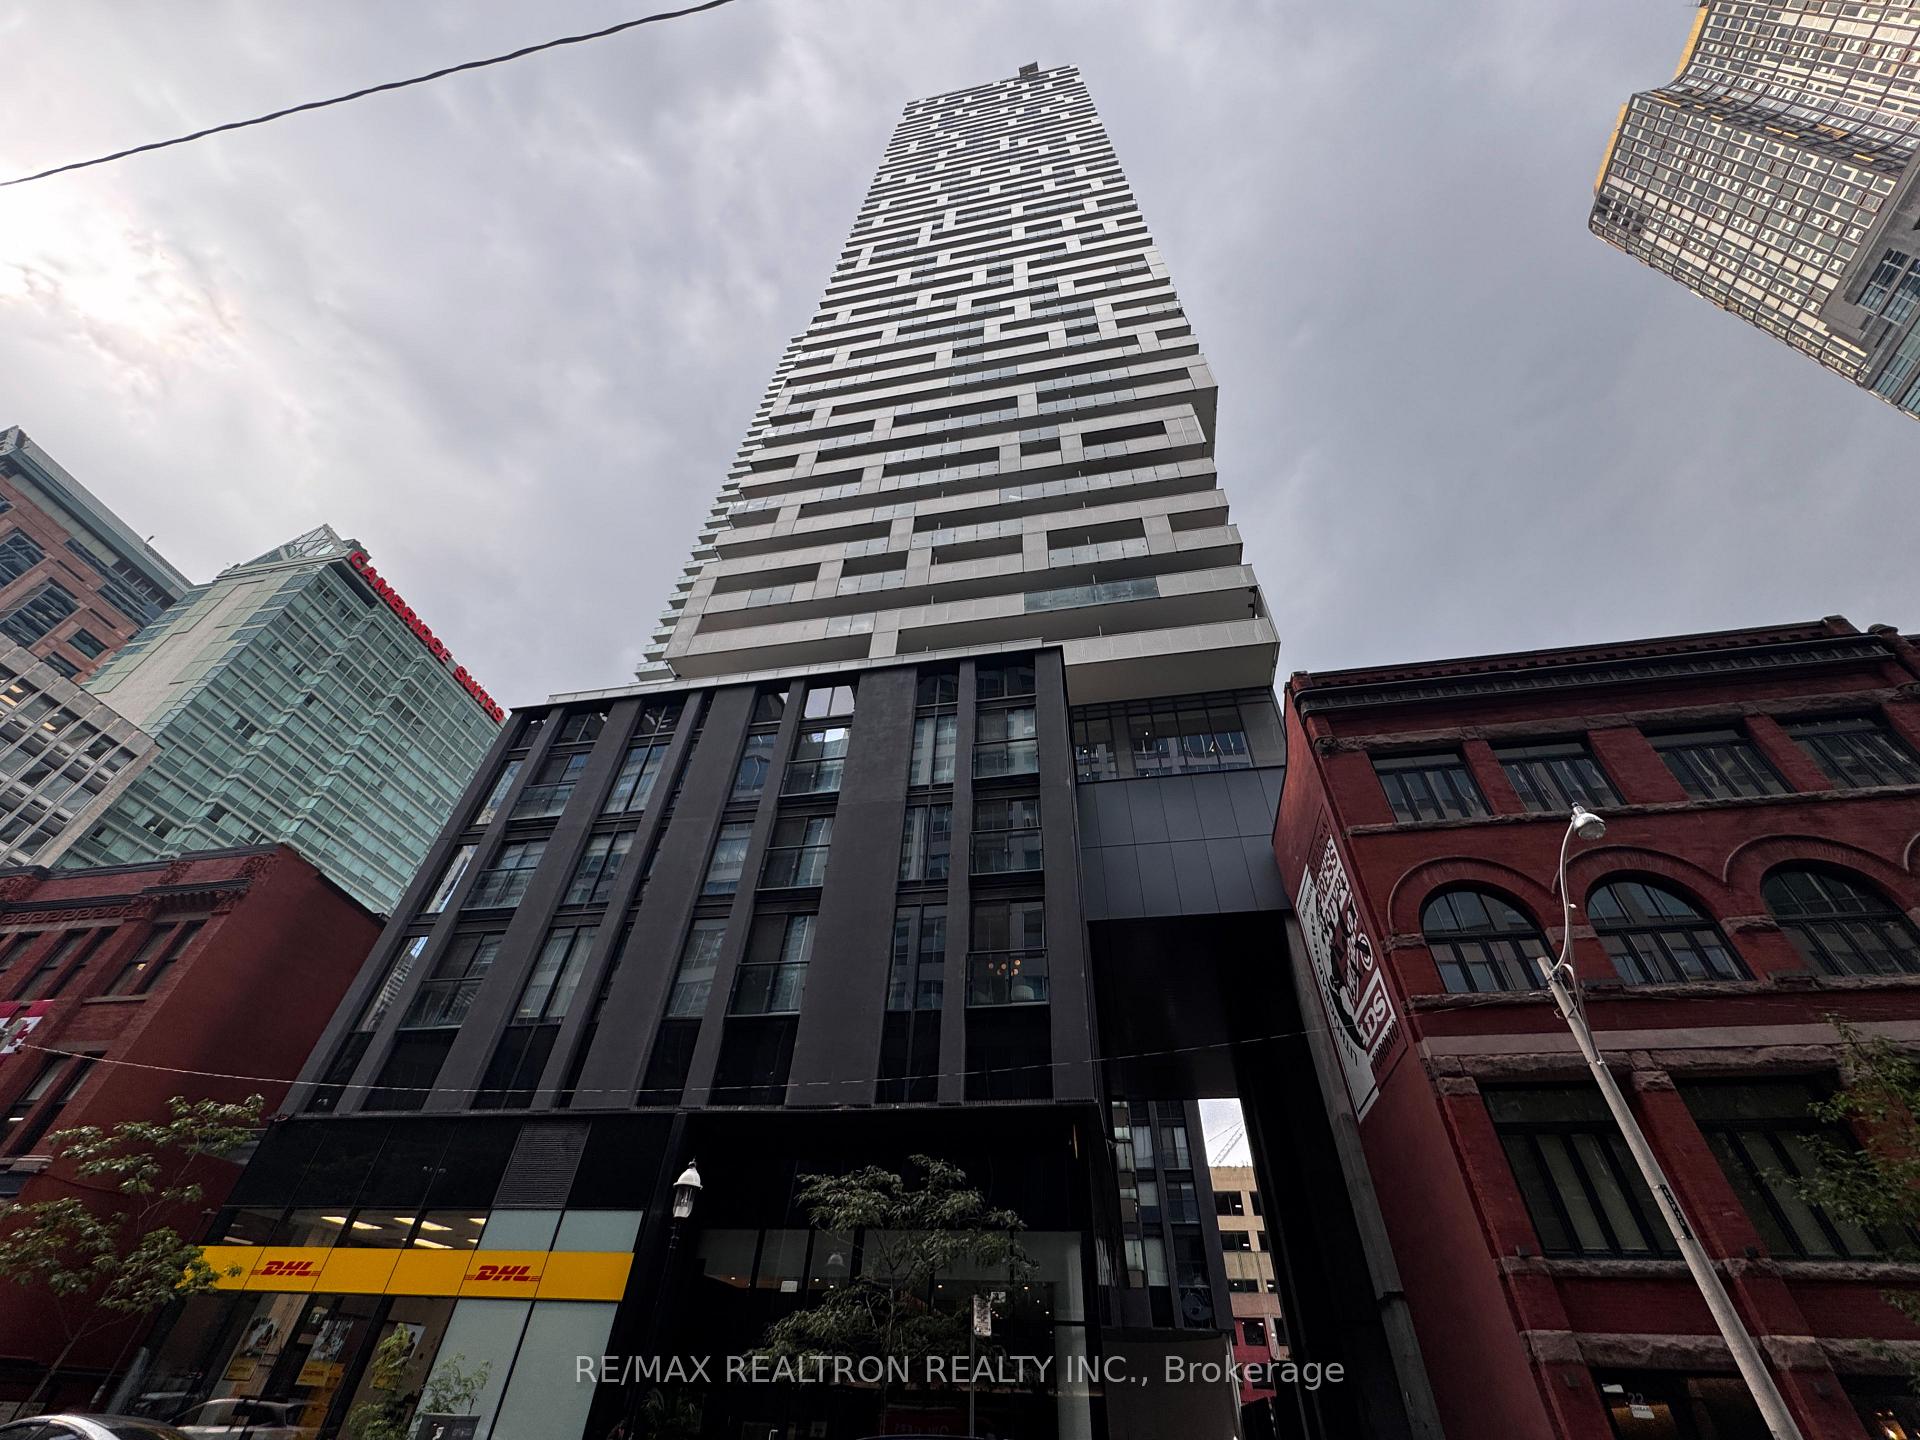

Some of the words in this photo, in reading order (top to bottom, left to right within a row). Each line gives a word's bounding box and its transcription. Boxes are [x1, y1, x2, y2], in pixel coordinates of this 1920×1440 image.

[350, 551, 453, 664] CAMBRIDGE
[453, 666, 505, 722] SUITES
[1315, 847, 1338, 905] PRESS
[1371, 1020, 1400, 1072] TORONTO
[260, 1260, 314, 1277] DHL
[474, 1265, 531, 1282] DHL
